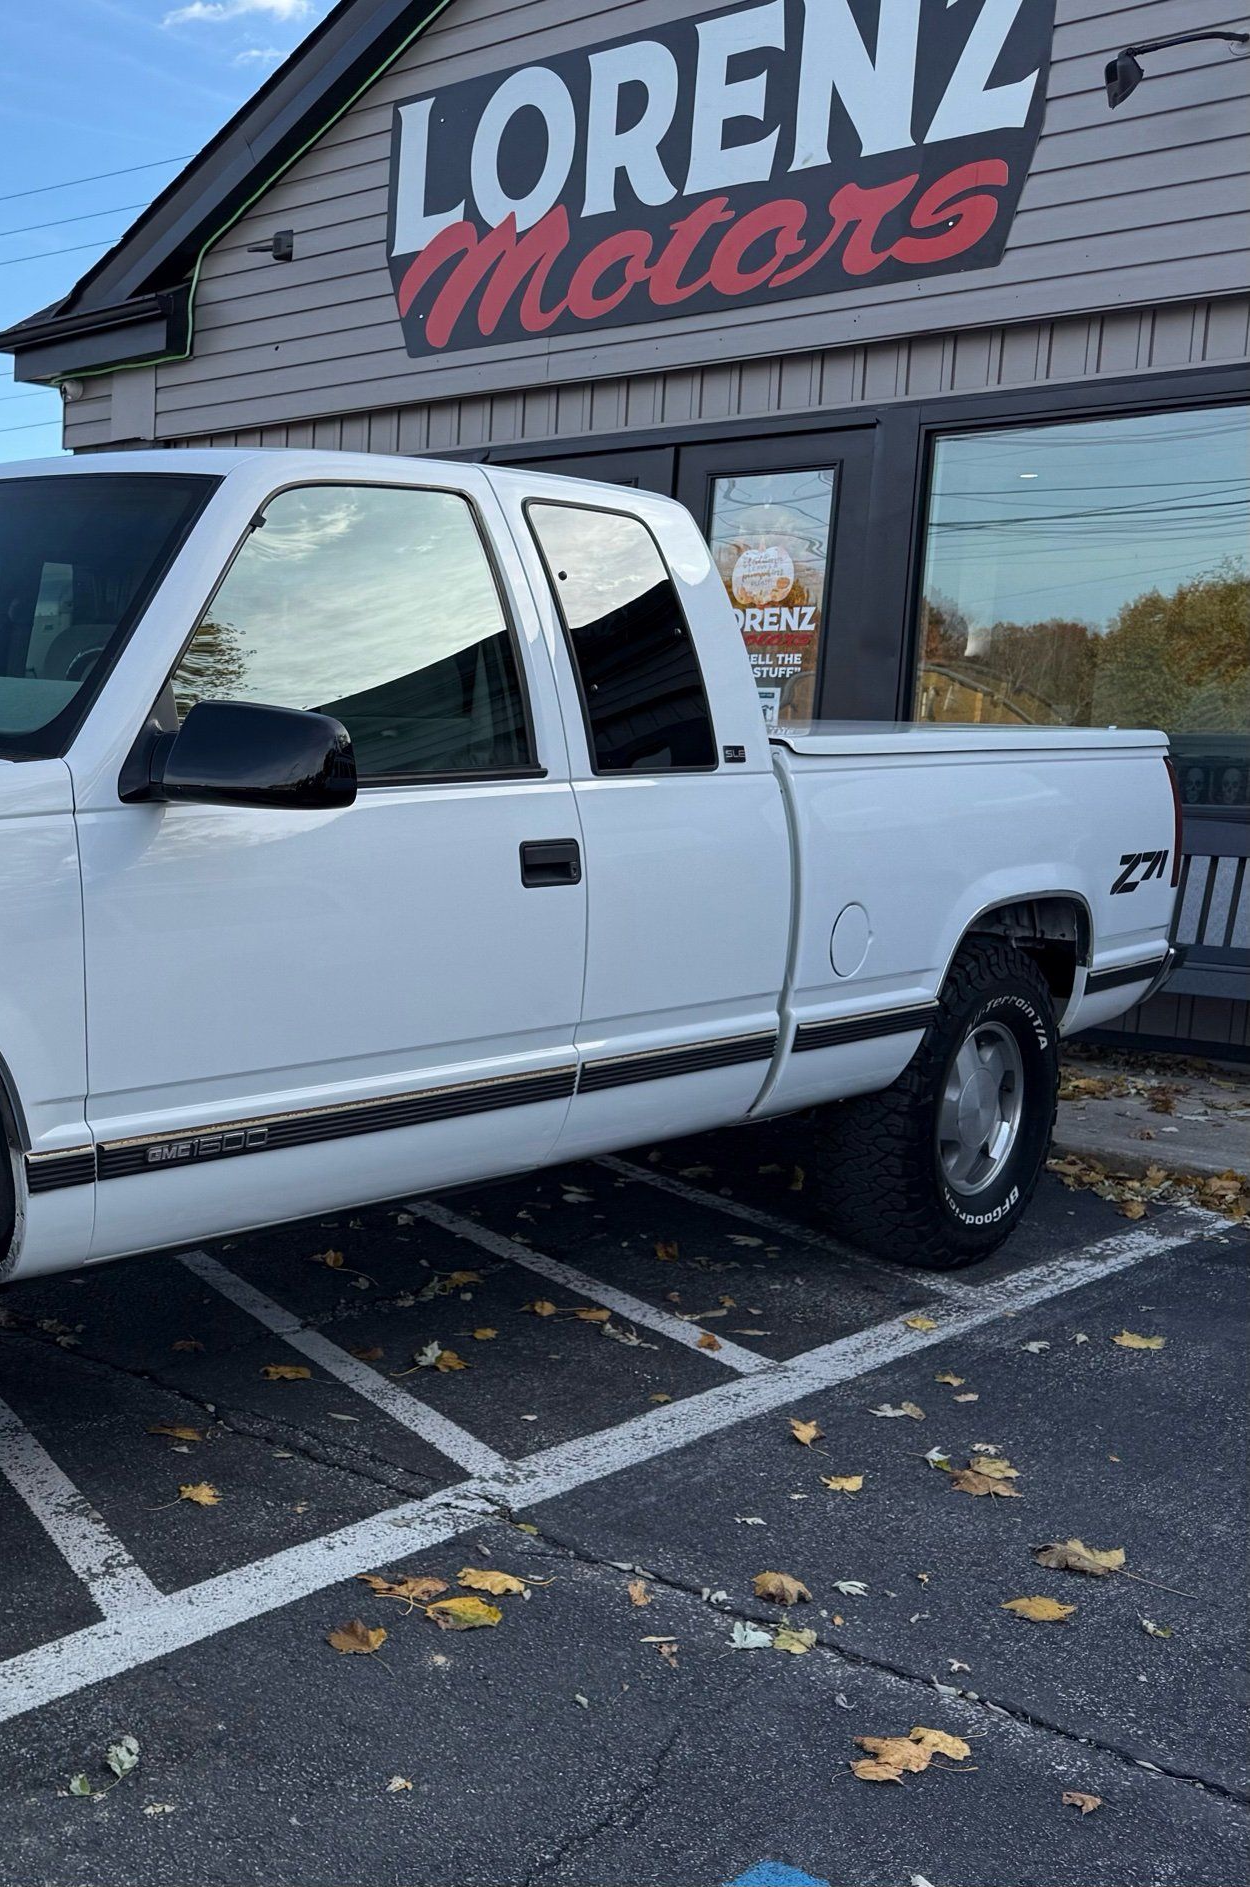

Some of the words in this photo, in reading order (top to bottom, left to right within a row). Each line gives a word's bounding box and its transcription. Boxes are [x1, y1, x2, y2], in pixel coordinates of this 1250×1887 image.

[391, 0, 1040, 257] LORENZ
[399, 158, 1009, 348] Motors
[733, 606, 817, 632] RENZ
[750, 653, 773, 665] ELL
[776, 653, 802, 665] THE
[725, 749, 746, 758] SLE
[1109, 849, 1170, 896] Z71
[1032, 1016, 1049, 1050] T/A
[148, 1142, 192, 1163] GMC
[192, 1128, 269, 1157] 1500
[944, 1185, 1019, 1225] BFGoodrich
